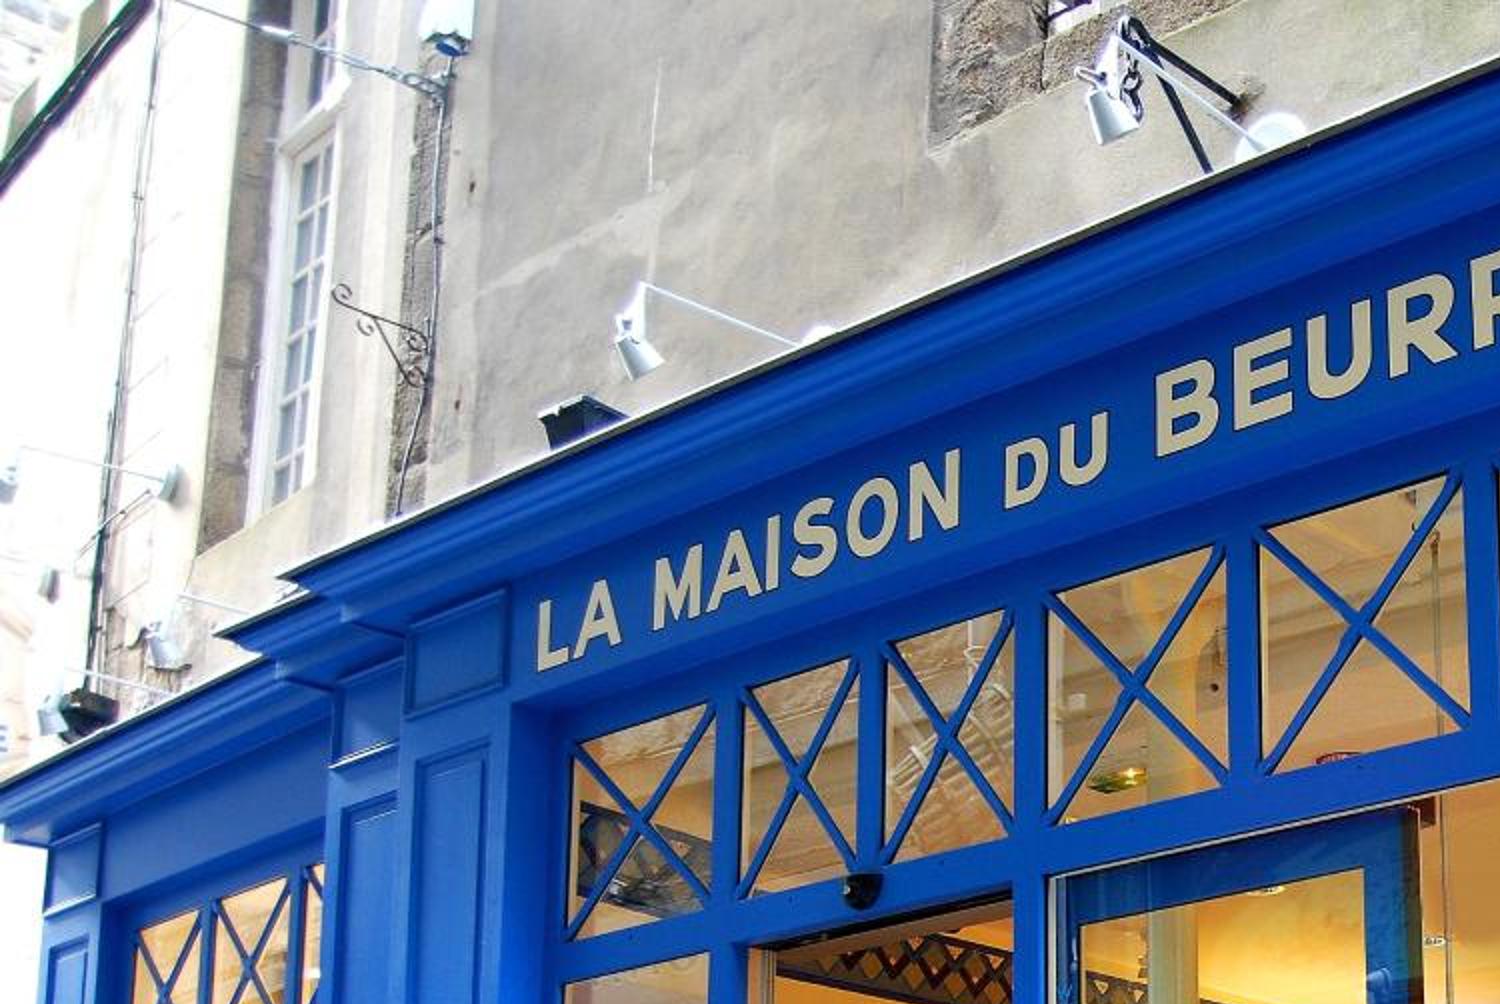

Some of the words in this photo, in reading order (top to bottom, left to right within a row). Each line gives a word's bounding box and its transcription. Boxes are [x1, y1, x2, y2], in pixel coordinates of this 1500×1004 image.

[536, 578, 622, 672] LA
[652, 447, 961, 632] MAISON
[1004, 410, 1109, 510] DU
